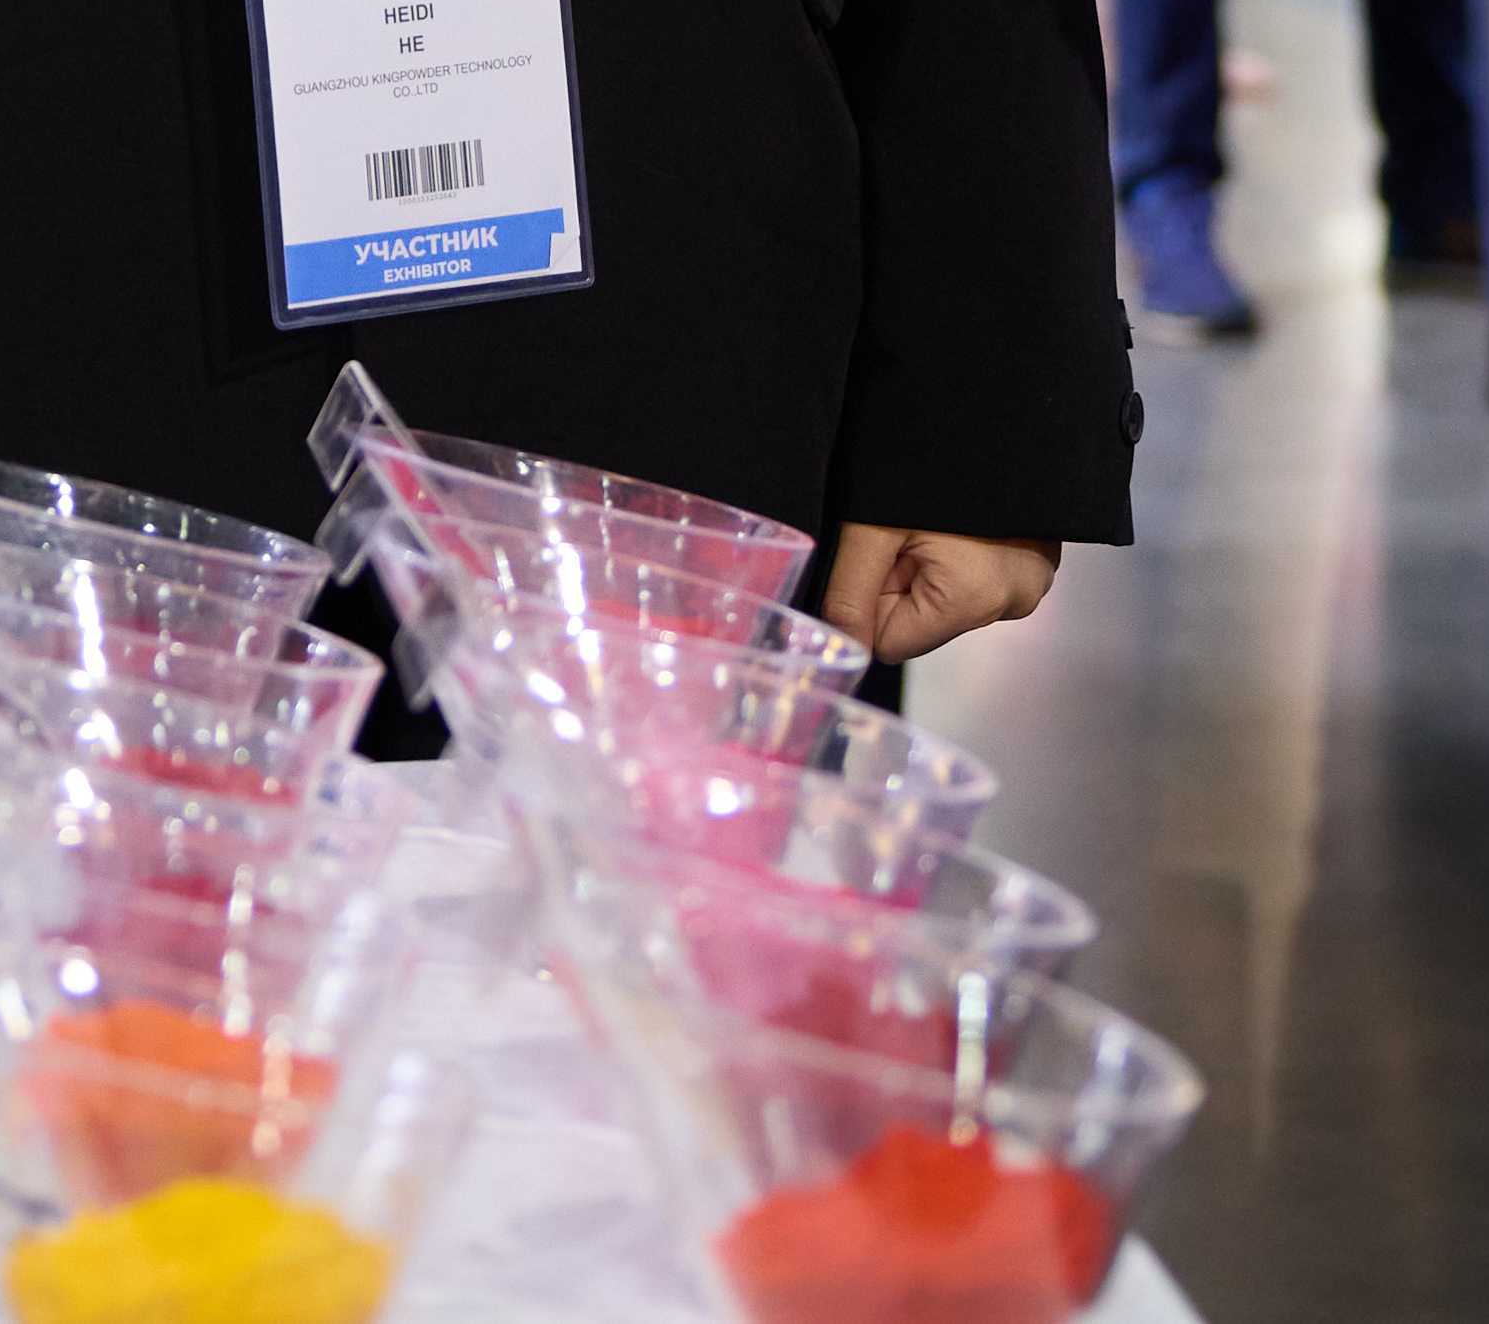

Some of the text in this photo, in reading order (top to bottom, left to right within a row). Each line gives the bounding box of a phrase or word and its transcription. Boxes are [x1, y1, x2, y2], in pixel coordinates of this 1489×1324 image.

[384, 3, 434, 24] HEIDI
[398, 35, 425, 53] HE
[293, 54, 533, 96] GUANGZHOU KINGPOWDER TECHNOLOGY
[354, 225, 499, 266] УЧАСТНИК
[383, 258, 472, 283] EXHIBITOR
